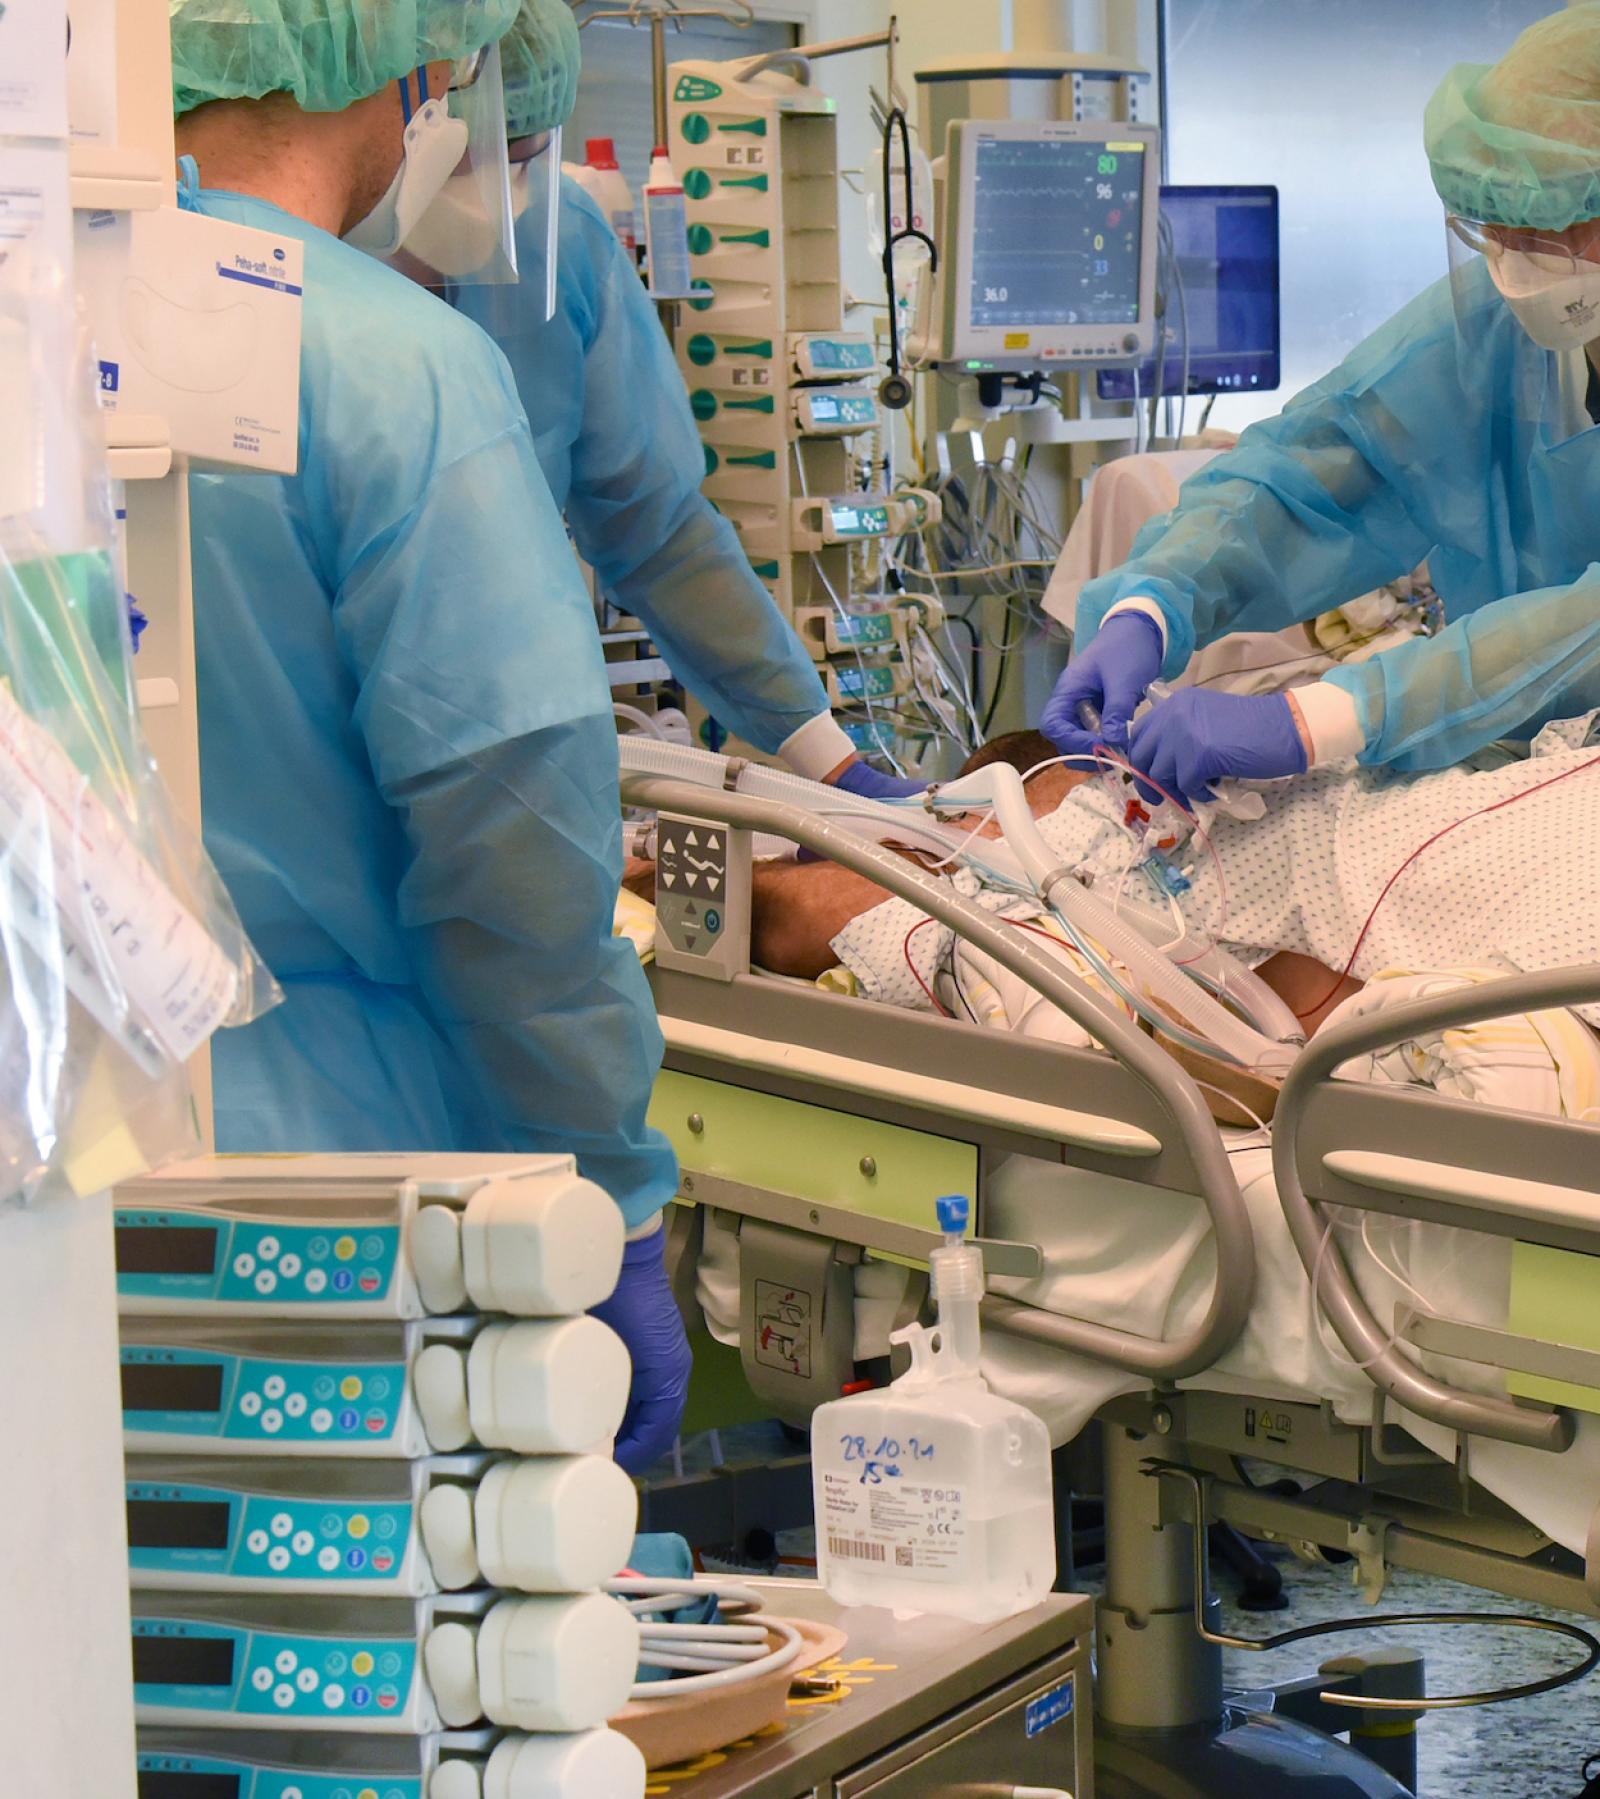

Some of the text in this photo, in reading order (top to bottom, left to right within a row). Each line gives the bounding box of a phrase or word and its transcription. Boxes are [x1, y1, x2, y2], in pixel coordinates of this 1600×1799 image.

[1097, 154, 1118, 175] 80
[1096, 183, 1113, 199] 96
[1093, 233, 1104, 251] 0
